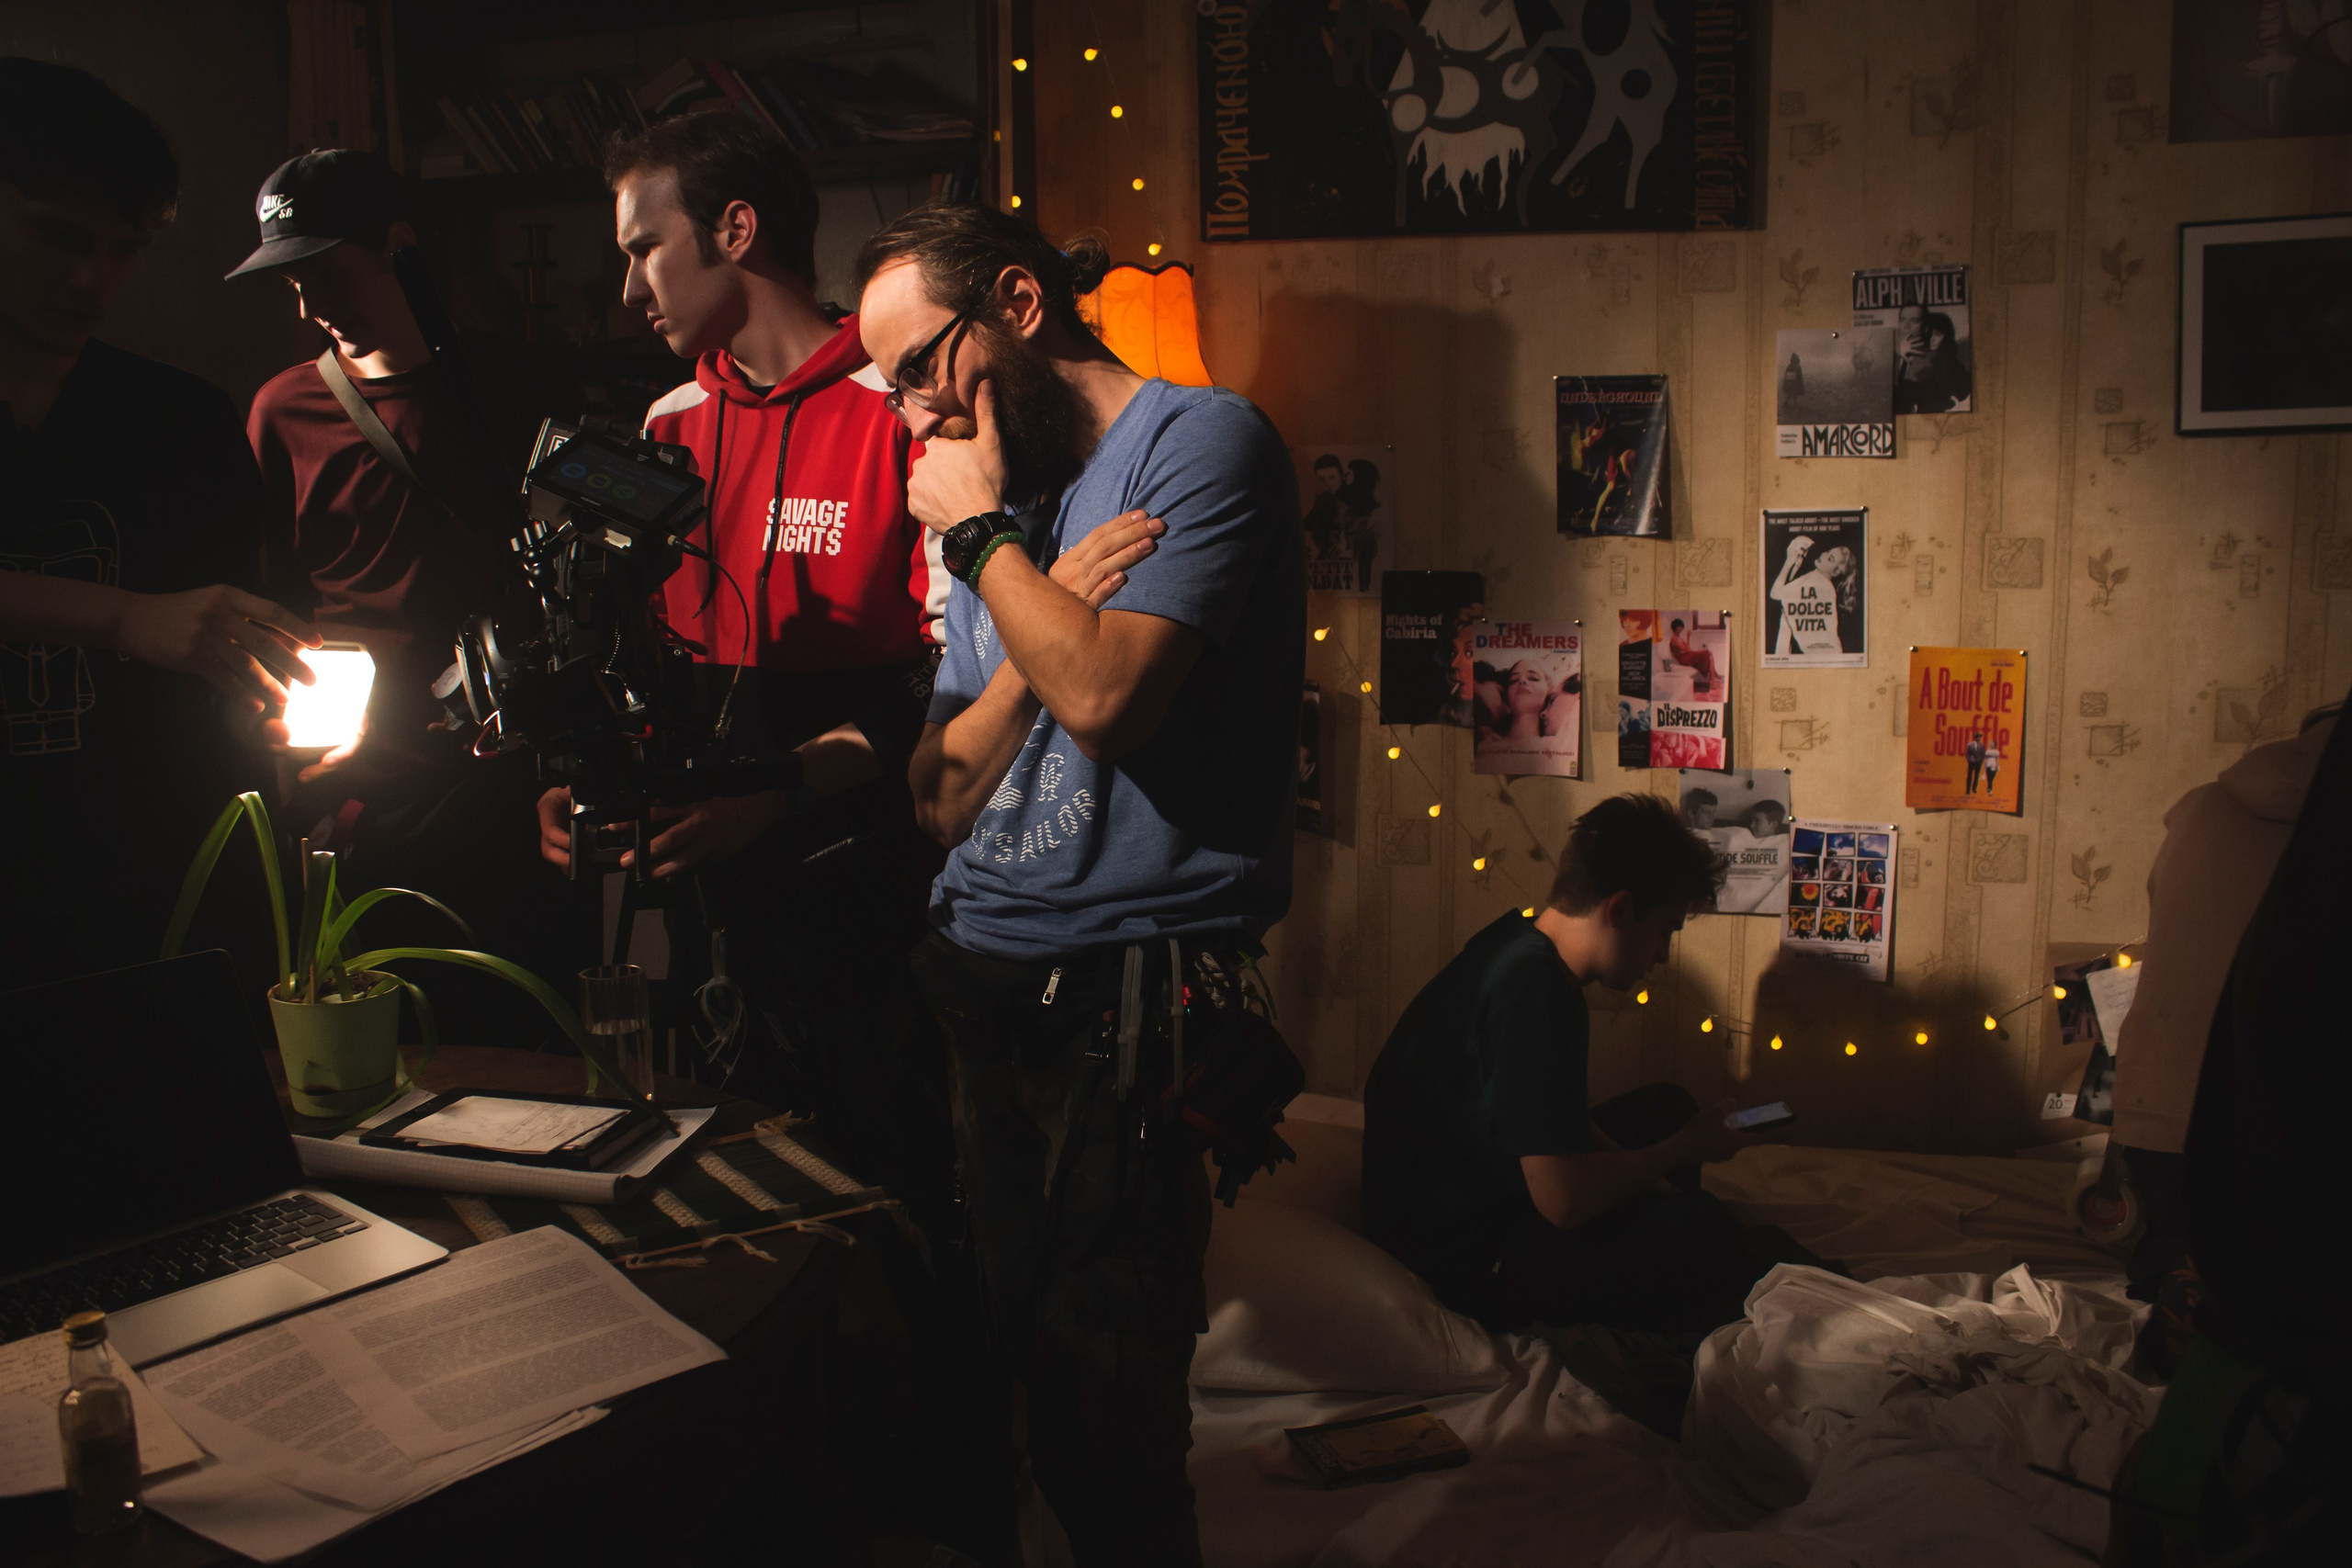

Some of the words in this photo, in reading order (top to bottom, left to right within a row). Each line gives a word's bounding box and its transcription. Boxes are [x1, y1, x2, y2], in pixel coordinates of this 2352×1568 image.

[263, 193, 285, 209] NIKE
[278, 207, 292, 219] SB
[1803, 423, 1894, 457] AMARCORD
[1801, 586, 1817, 600] LA
[1788, 603, 1833, 615] DOLCE
[1385, 614, 1427, 628] Nights
[1430, 614, 1443, 626] of
[1795, 618, 1826, 632] VITA
[1385, 626, 1438, 640] Cabiria
[1495, 623, 1532, 637] THE
[1476, 635, 1578, 649] DREAMERS
[1919, 666, 1932, 710] A
[1937, 666, 1984, 712] Bout
[1988, 669, 2014, 714] de
[995, 788, 1097, 863] SAILOR
[1726, 852, 1738, 863] DE
[1740, 852, 1779, 864] SOUFFLE
[2048, 1099, 2063, 1110] 20
